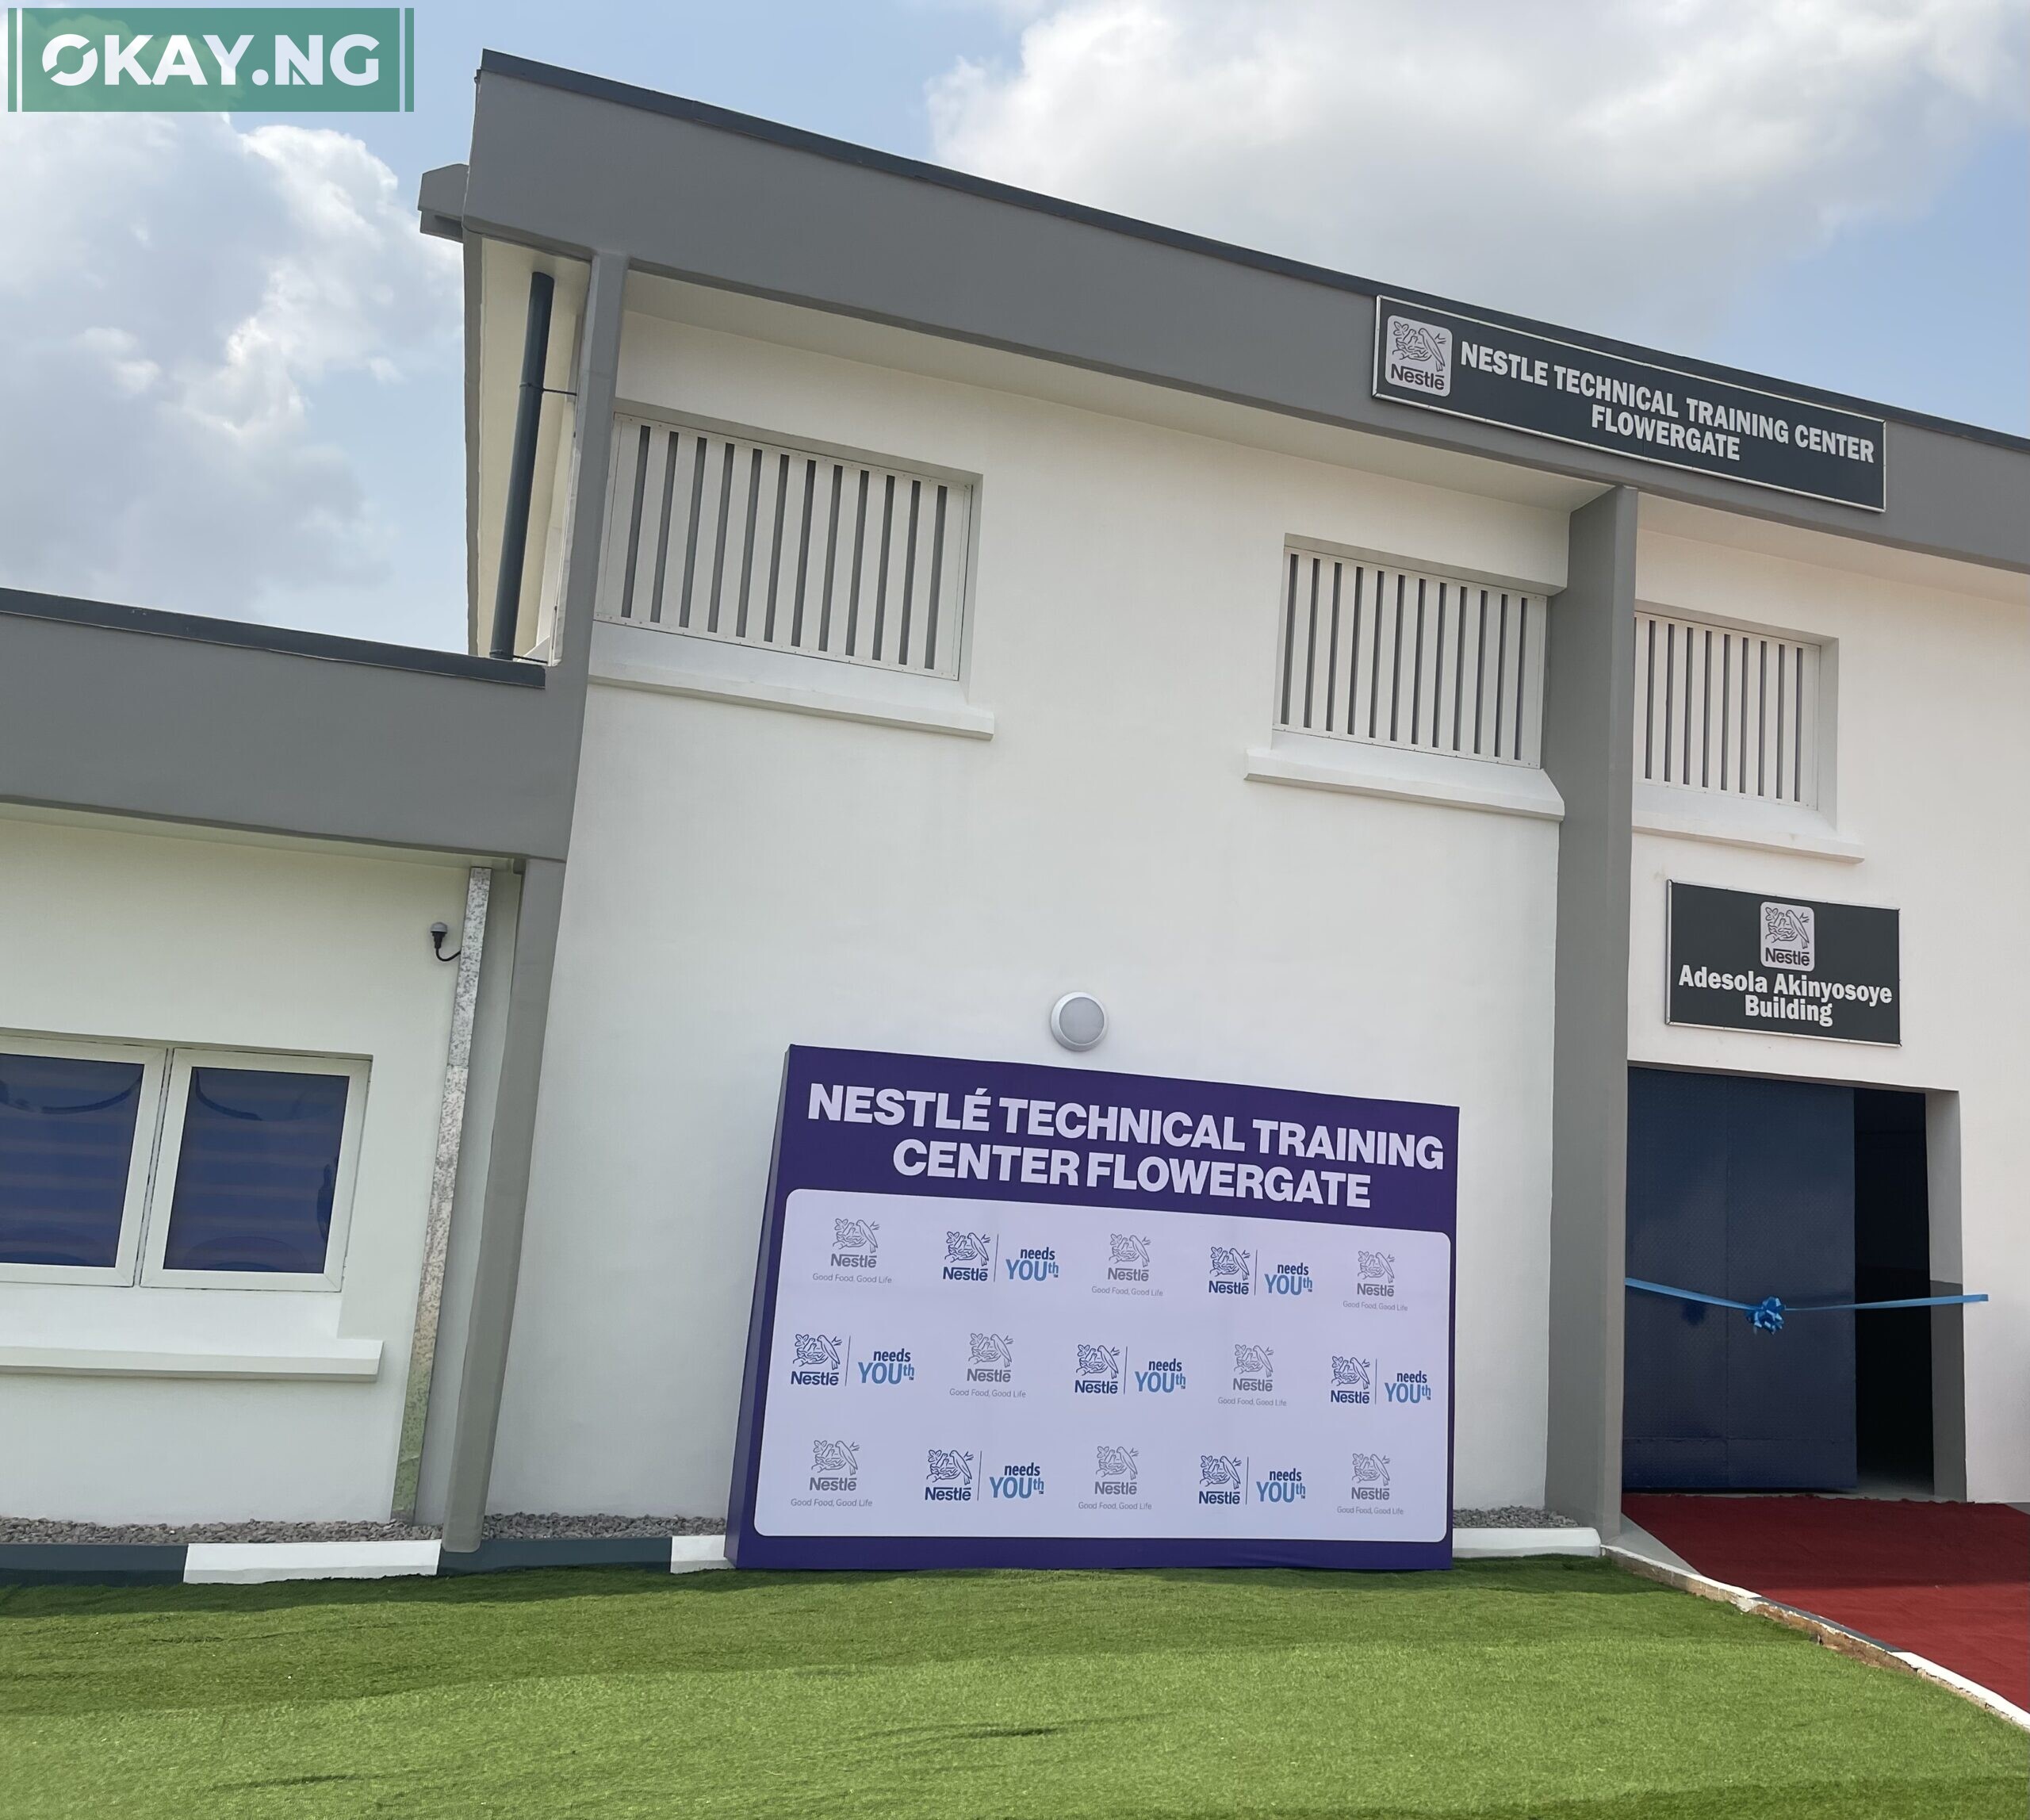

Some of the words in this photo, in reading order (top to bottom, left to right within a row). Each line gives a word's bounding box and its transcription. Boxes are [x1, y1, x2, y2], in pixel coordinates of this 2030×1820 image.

[1461, 341, 1548, 386] NESTLE
[1554, 365, 1679, 418] TECHNICAL
[1686, 397, 1788, 444] TRAINING
[1794, 425, 1874, 463] CENTER
[1591, 404, 1740, 460] FLOWERGATE
[1679, 964, 1768, 994] Adesola
[1774, 973, 1892, 1007] Akinyosoye
[1745, 994, 1833, 1027] Building
[808, 1083, 990, 1132] NESTLÉ
[1001, 1098, 1245, 1151] TECHNICAL
[1253, 1120, 1444, 1171] TRAINING
[893, 1138, 1077, 1186] CENTER
[1087, 1152, 1371, 1208] FLOWERGATE
[1020, 1247, 1055, 1260] needs
[1277, 1263, 1308, 1275] needs
[813, 1273, 833, 1282] Good
[856, 1274, 877, 1283] Good
[1091, 1286, 1110, 1295] Good
[873, 1348, 910, 1362] needs
[1148, 1358, 1182, 1372] needs
[1397, 1370, 1427, 1383] needs
[1004, 1462, 1040, 1476] needs
[1269, 1469, 1301, 1481] needs
